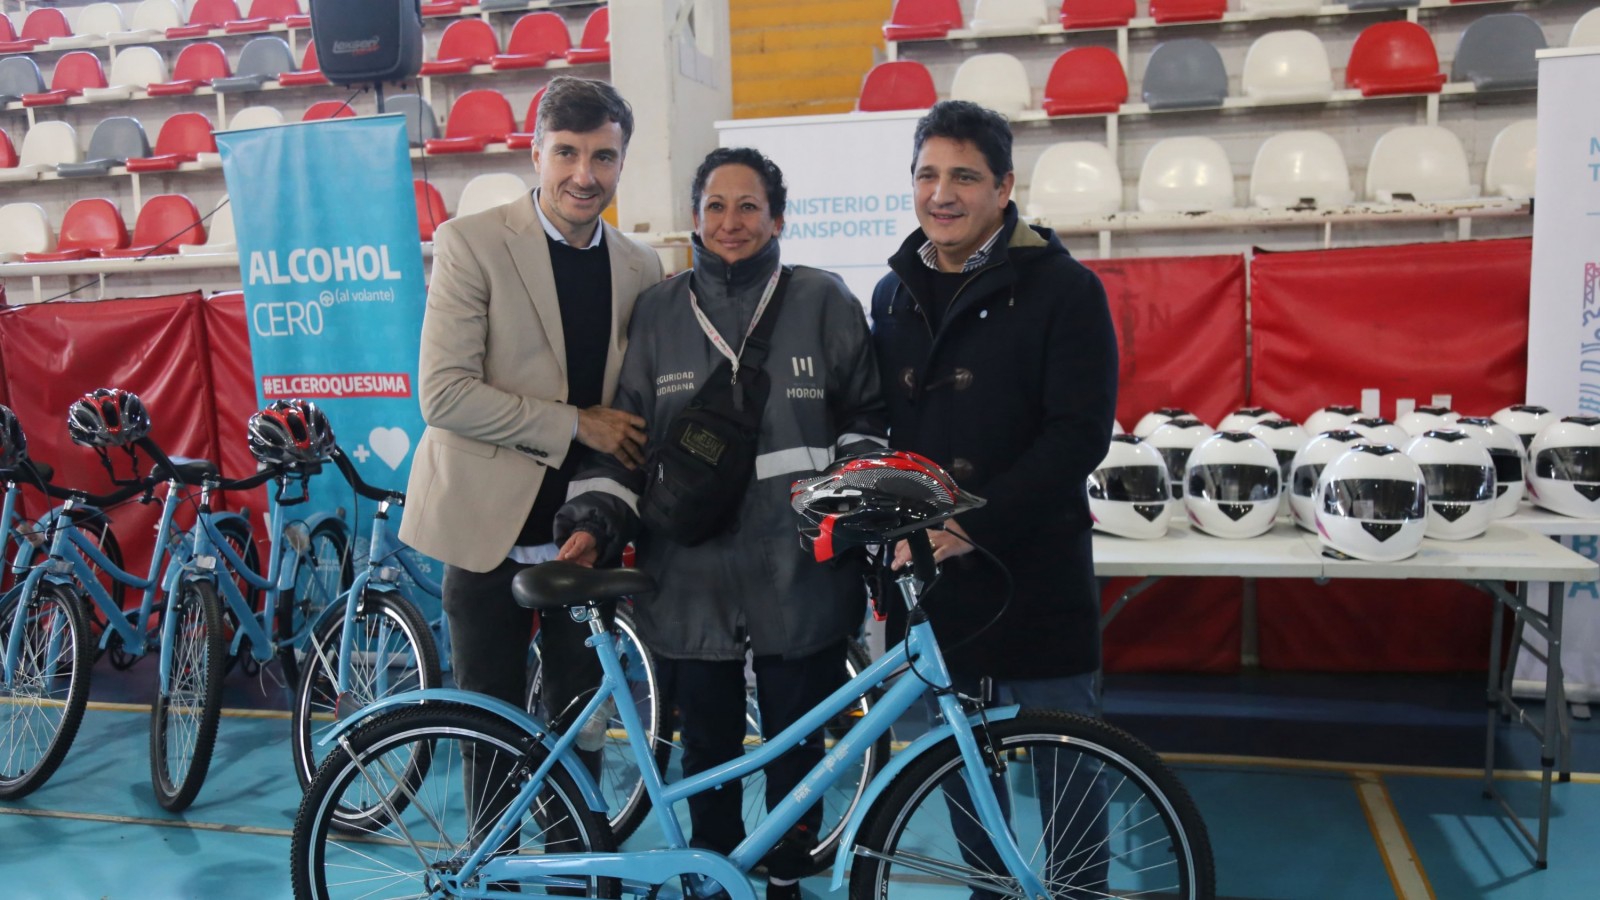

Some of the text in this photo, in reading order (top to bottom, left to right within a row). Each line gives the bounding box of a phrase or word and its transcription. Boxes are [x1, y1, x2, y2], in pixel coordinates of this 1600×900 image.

[786, 194, 913, 216] NISTERIO DE
[781, 219, 897, 240] RANSPORTE
[249, 245, 402, 286] ALCOHOL
[335, 287, 394, 303] (al volante)
[263, 376, 407, 395] #ELCEROQUESUMA
[656, 382, 695, 396] UDADANA
